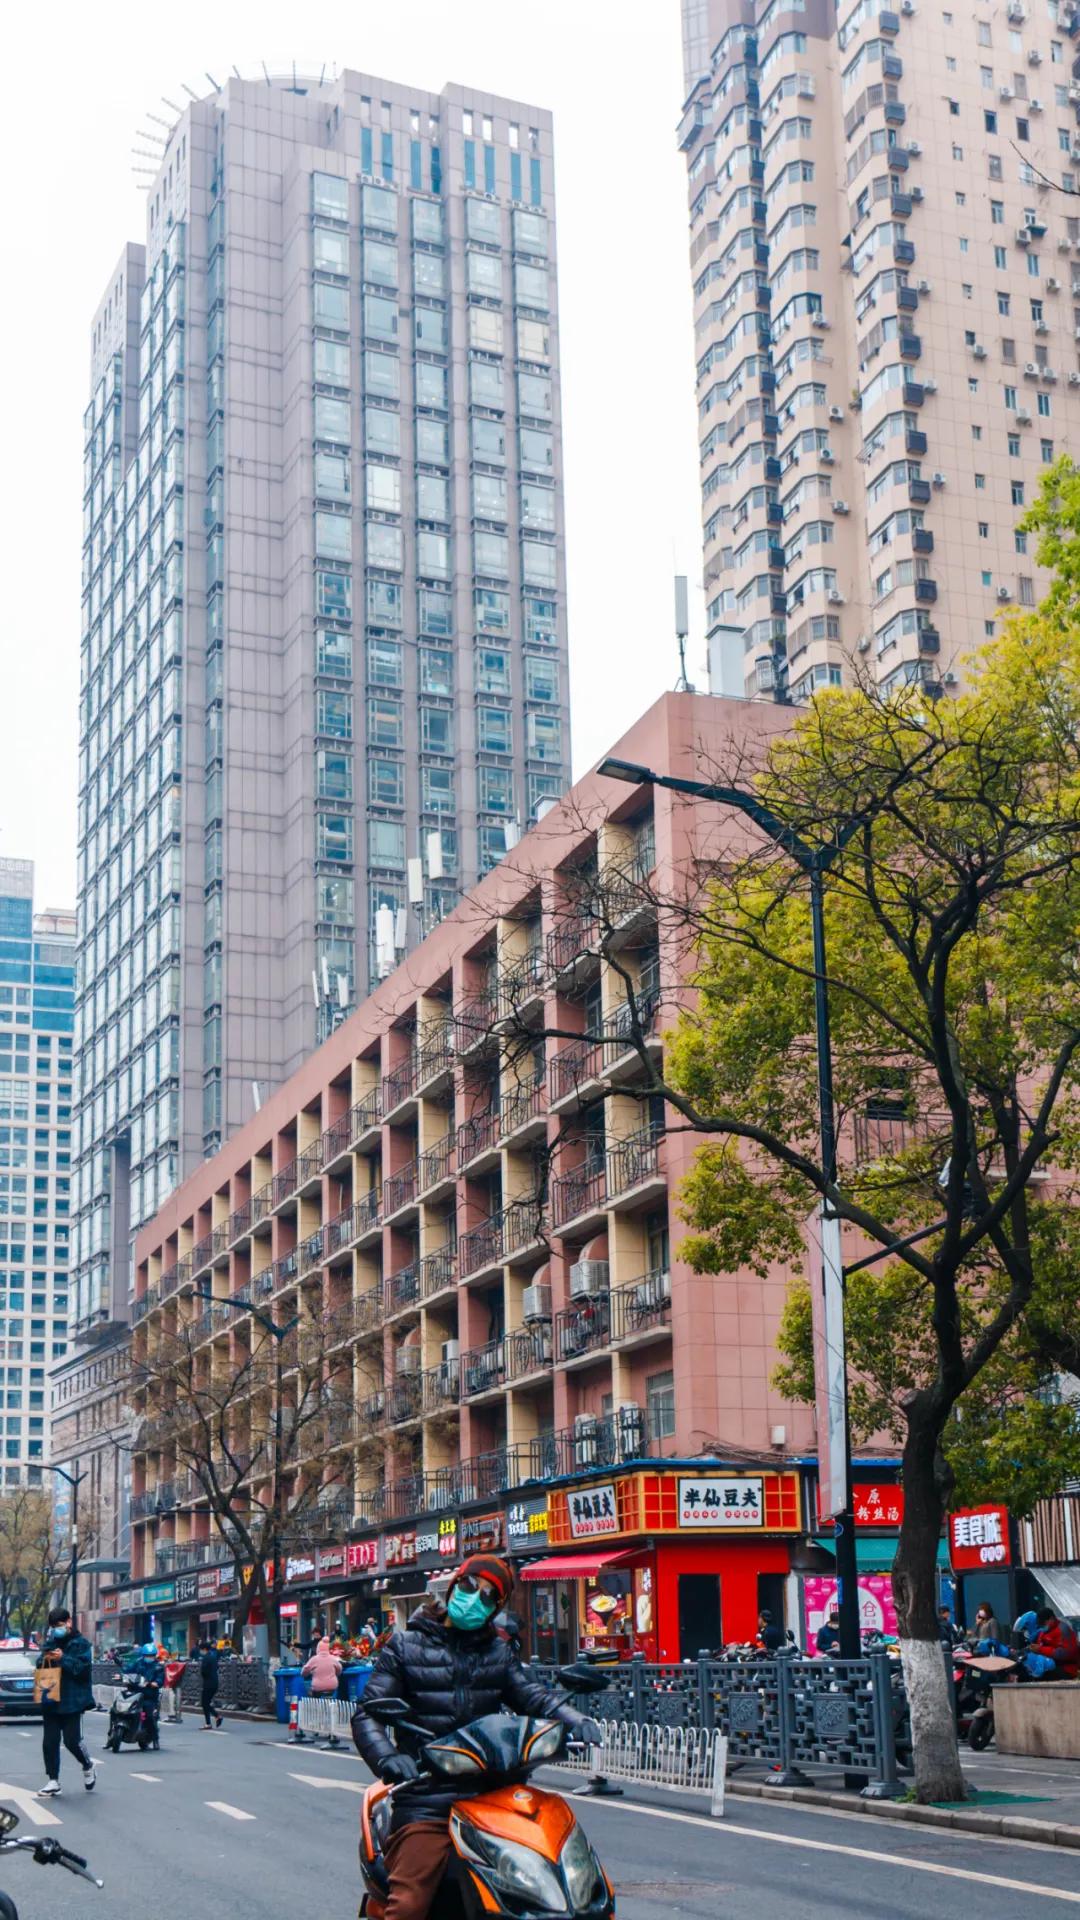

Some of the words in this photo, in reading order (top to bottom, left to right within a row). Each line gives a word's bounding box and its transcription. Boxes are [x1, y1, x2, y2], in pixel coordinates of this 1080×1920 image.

[573, 1492, 613, 1522] 半仙豆夫
[684, 1488, 759, 1508] 半仙豆夫
